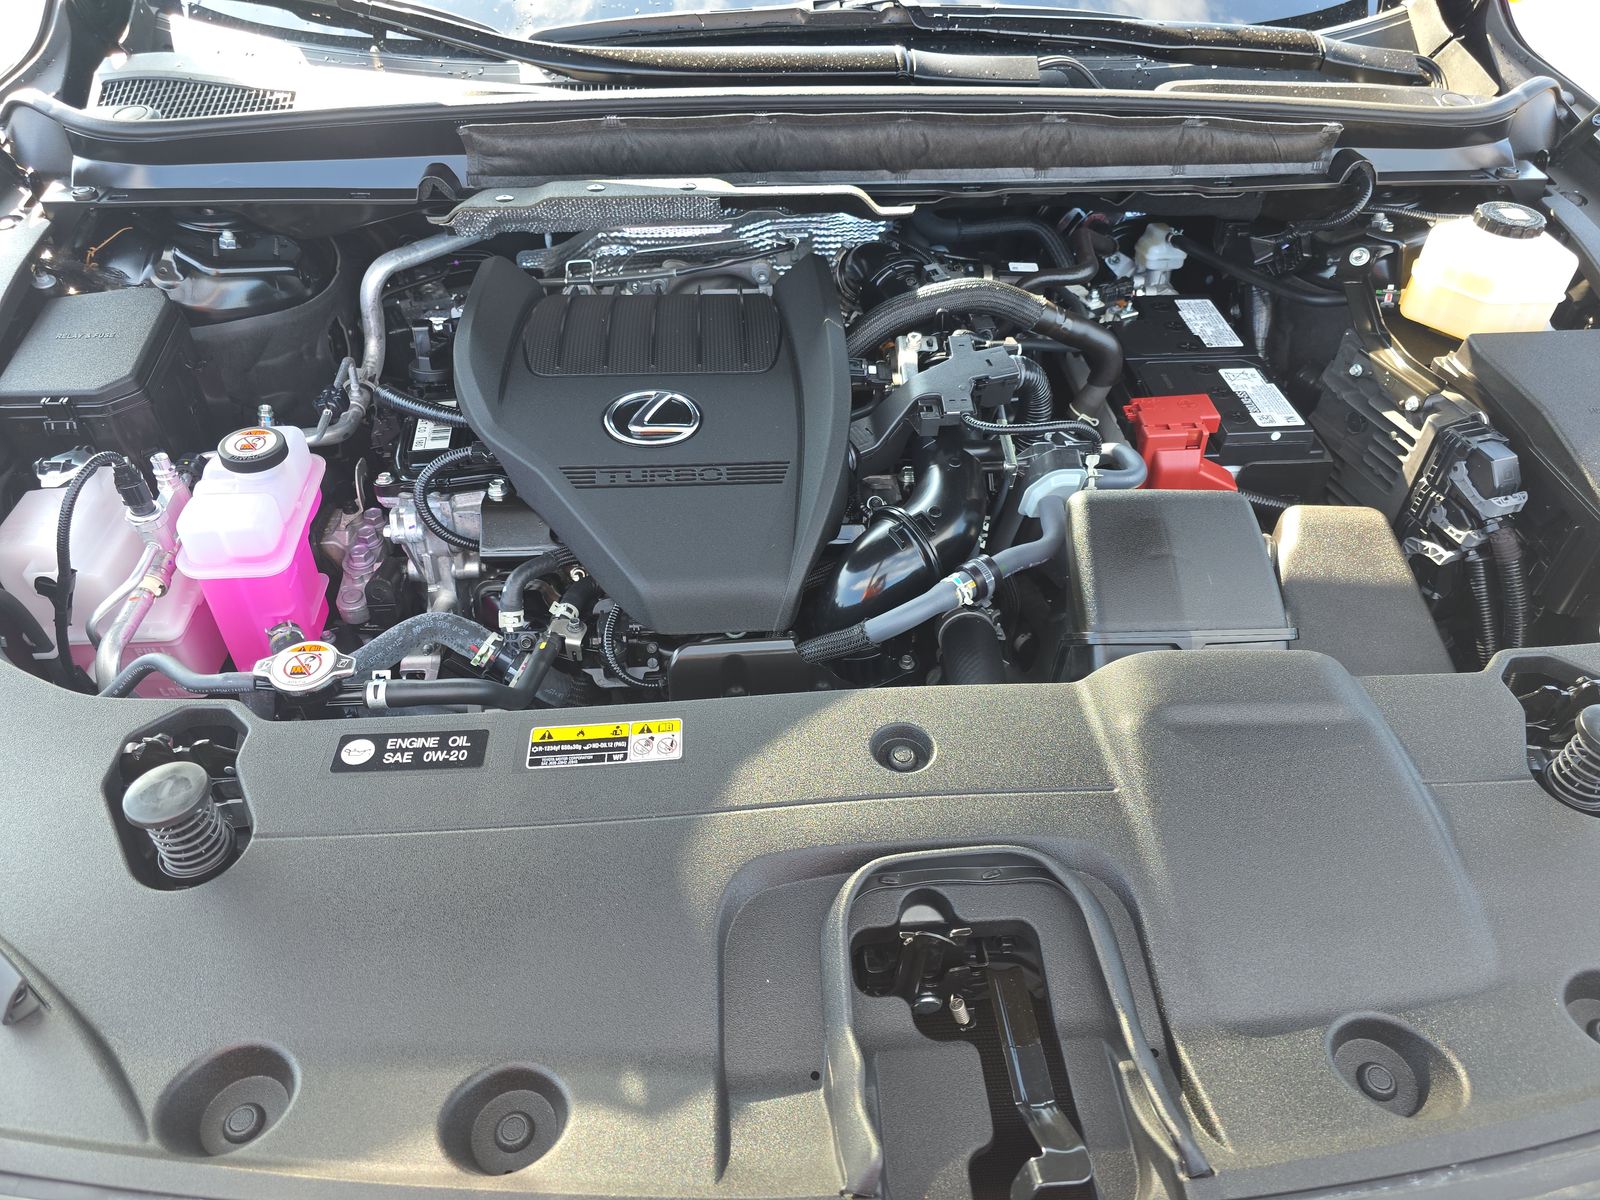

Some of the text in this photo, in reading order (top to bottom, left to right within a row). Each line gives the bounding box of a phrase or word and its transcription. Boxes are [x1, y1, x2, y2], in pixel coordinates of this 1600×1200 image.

[600, 467, 723, 484] TURBO
[386, 736, 471, 750] ENGINE OIL
[383, 750, 468, 764] SAE 0W-20
